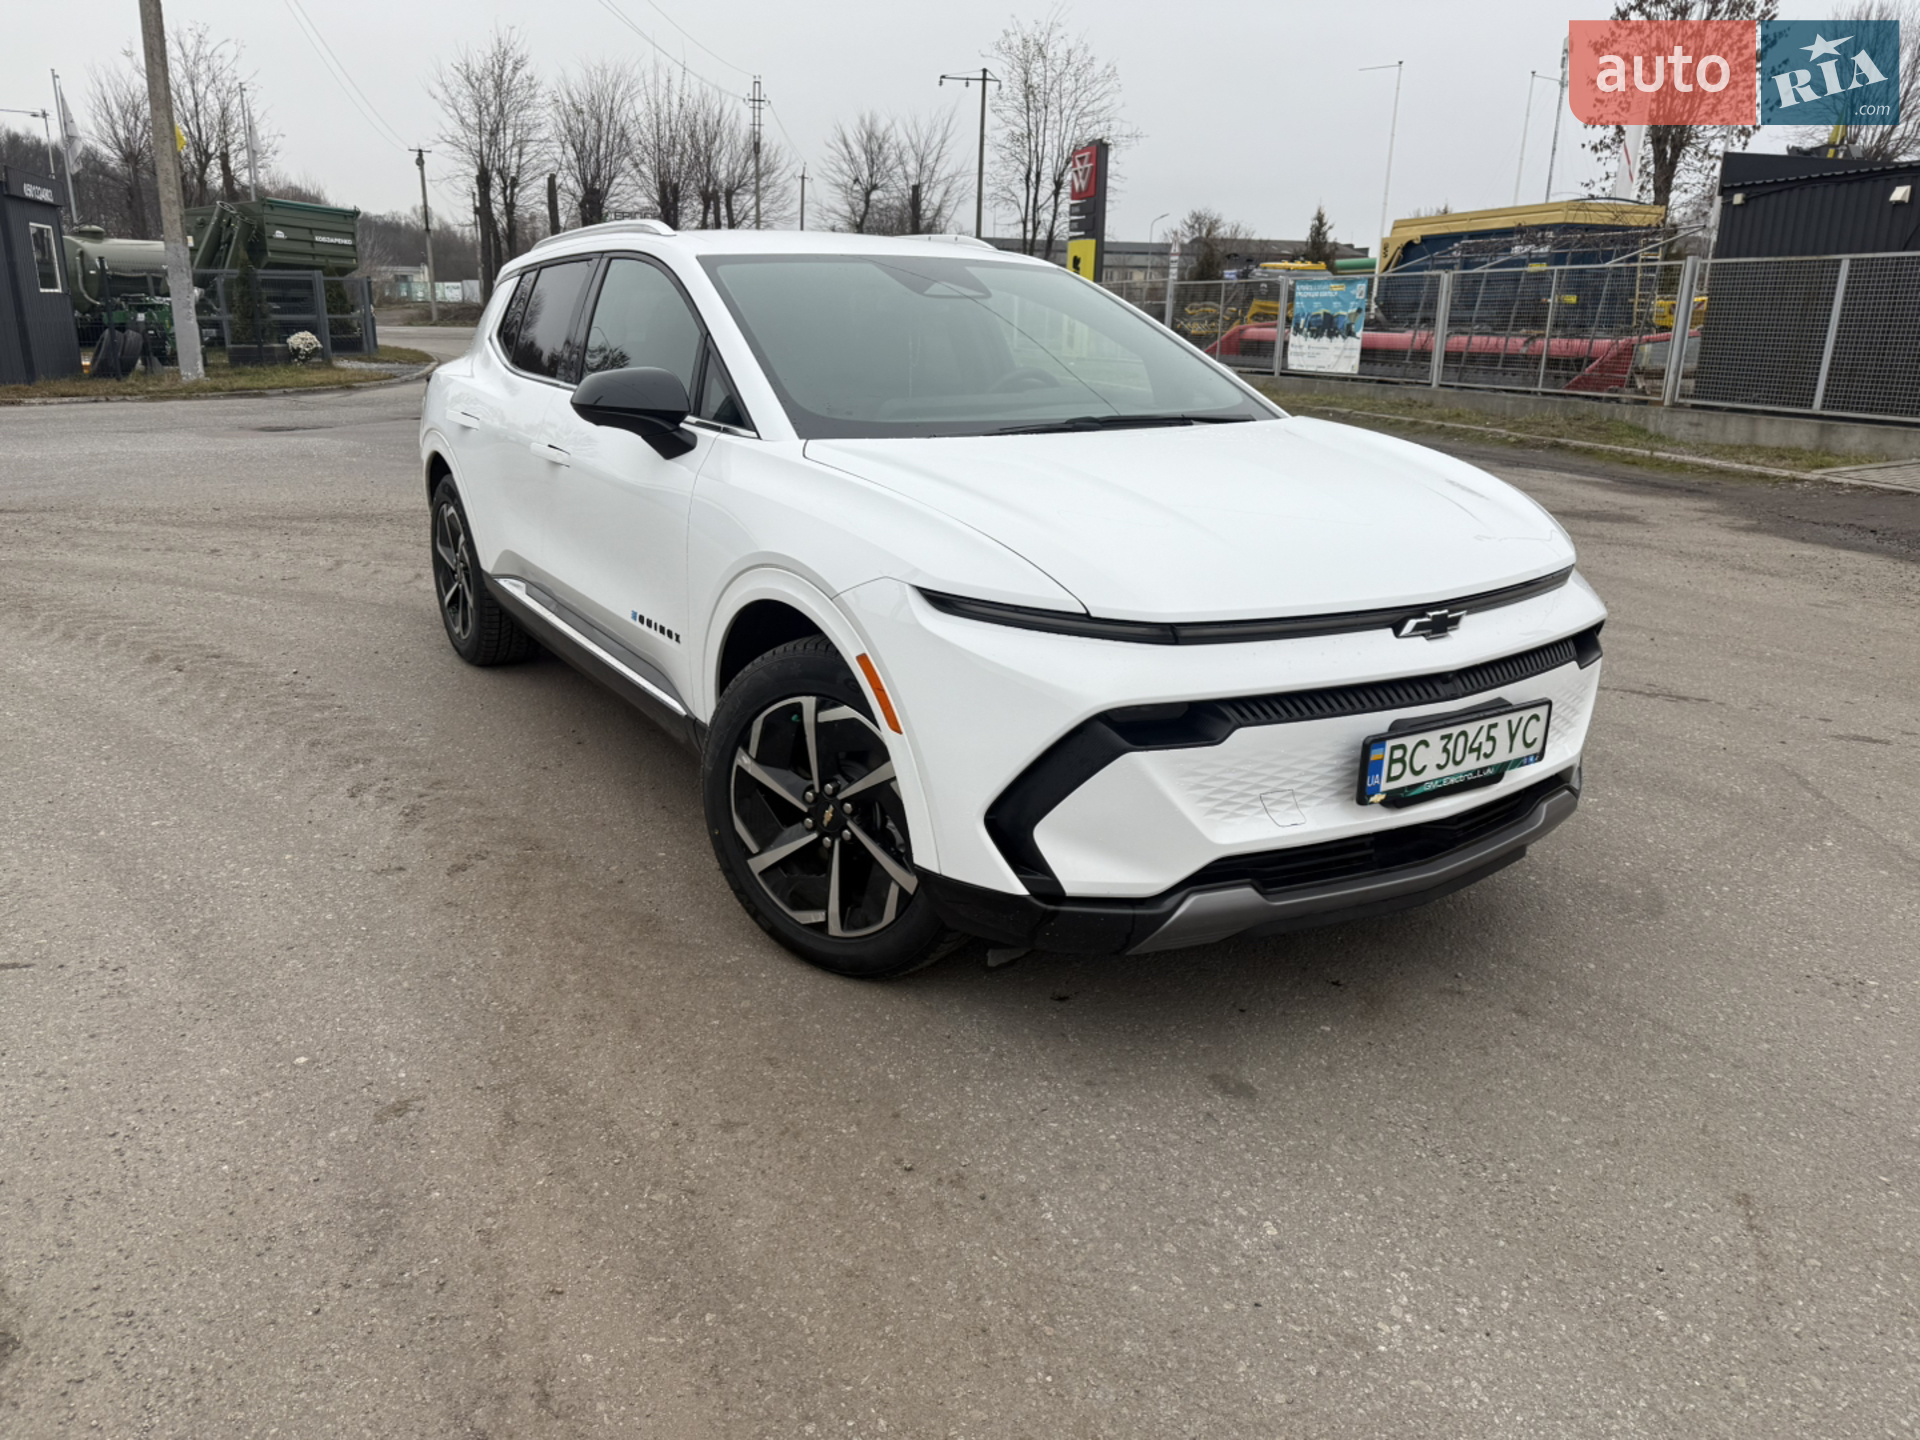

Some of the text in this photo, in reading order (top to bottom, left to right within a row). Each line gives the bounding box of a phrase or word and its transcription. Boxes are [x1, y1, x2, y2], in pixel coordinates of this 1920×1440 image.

[631, 610, 681, 645] EQUINOX
[1385, 713, 1541, 784] BC 3045 YC
[1367, 774, 1381, 787] UA
